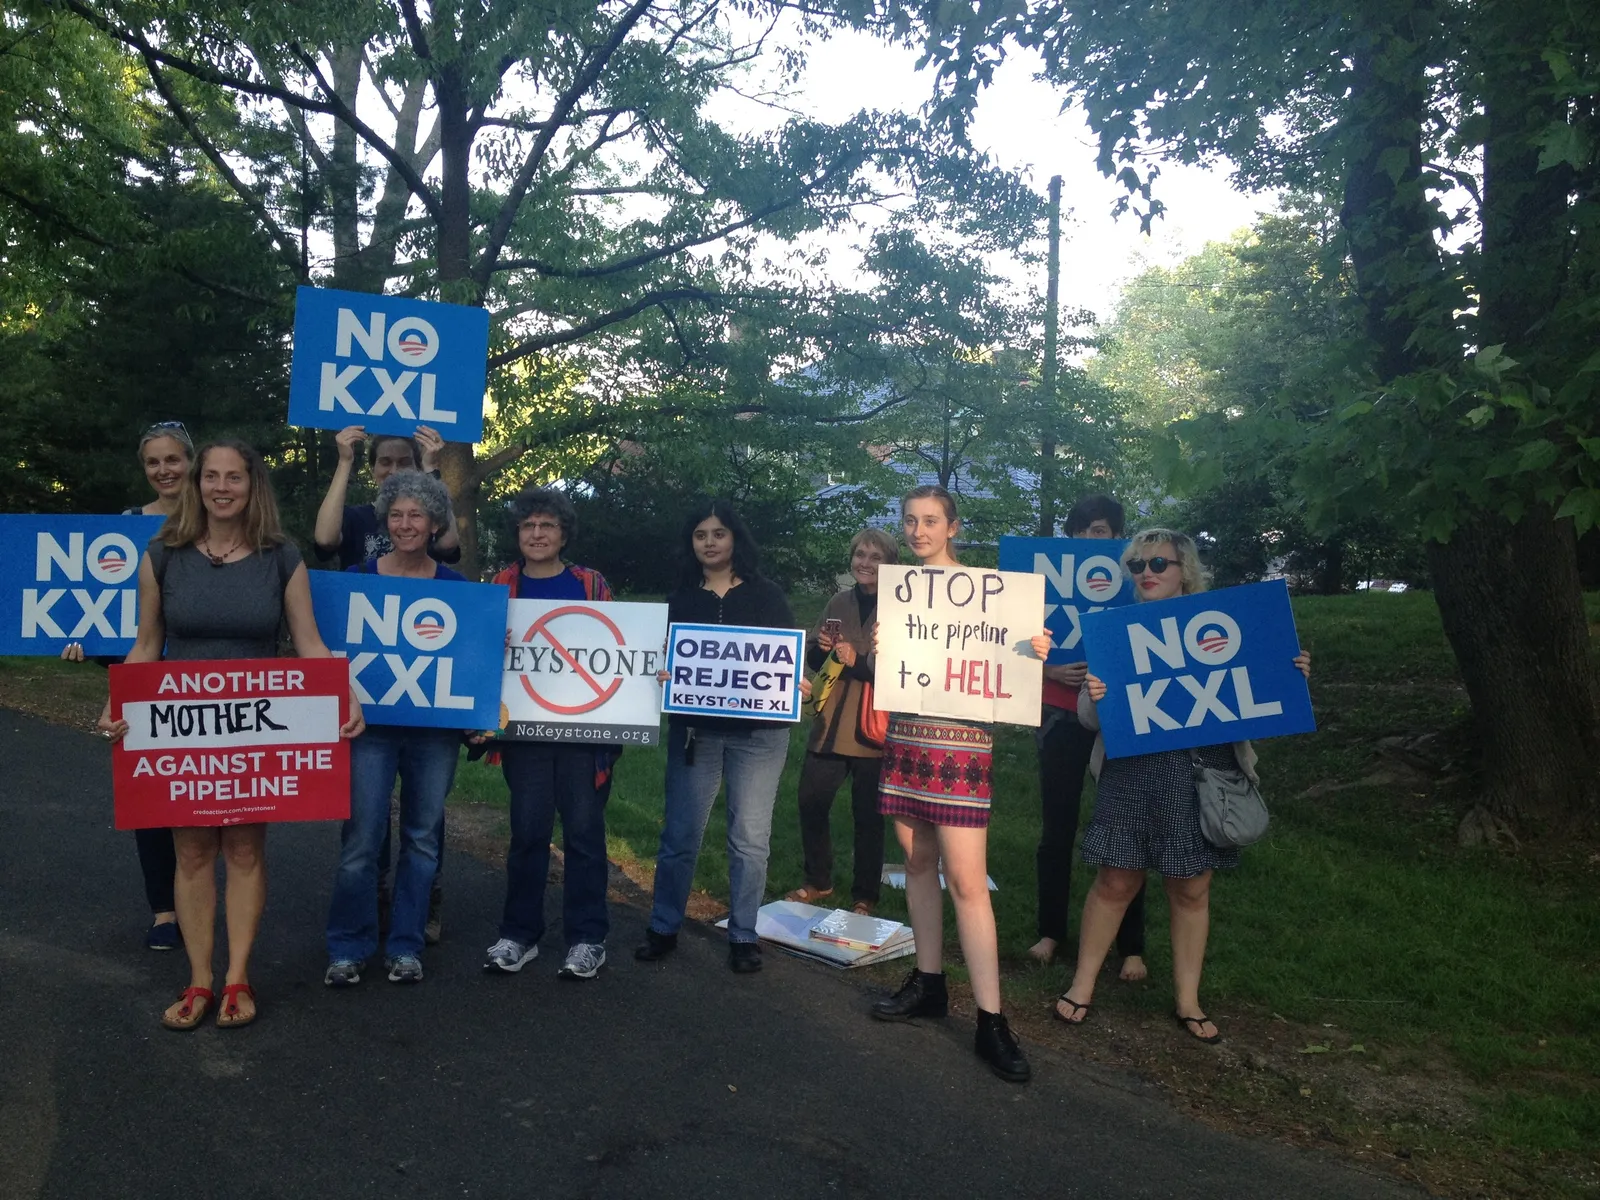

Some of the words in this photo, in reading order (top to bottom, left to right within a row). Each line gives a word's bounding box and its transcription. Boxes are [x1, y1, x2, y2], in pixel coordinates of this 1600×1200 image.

[336, 308, 439, 367] NO
[319, 362, 457, 423] KXL
[36, 532, 138, 584] NO
[1034, 553, 1123, 602] NO
[895, 568, 1004, 613] STOP
[21, 589, 139, 638] KXL
[346, 592, 457, 651] NO
[905, 614, 939, 640] the
[946, 621, 1009, 650] pipeline
[503, 646, 659, 677] EYSTONE
[676, 638, 794, 665] OBAMA
[1127, 610, 1242, 675] NO
[157, 670, 304, 694] ANOTHER
[674, 666, 792, 692] REJECT
[898, 660, 931, 689] to
[944, 657, 1012, 698] HELL
[150, 699, 289, 738] MOTHER
[673, 693, 763, 710] KEYSTONE
[769, 700, 790, 712] XL
[1125, 666, 1283, 735] KXL
[515, 724, 650, 743] NoKeystone.org
[133, 752, 265, 777] AGAINST
[276, 750, 333, 770] THE
[170, 776, 299, 801] PIPELINE
